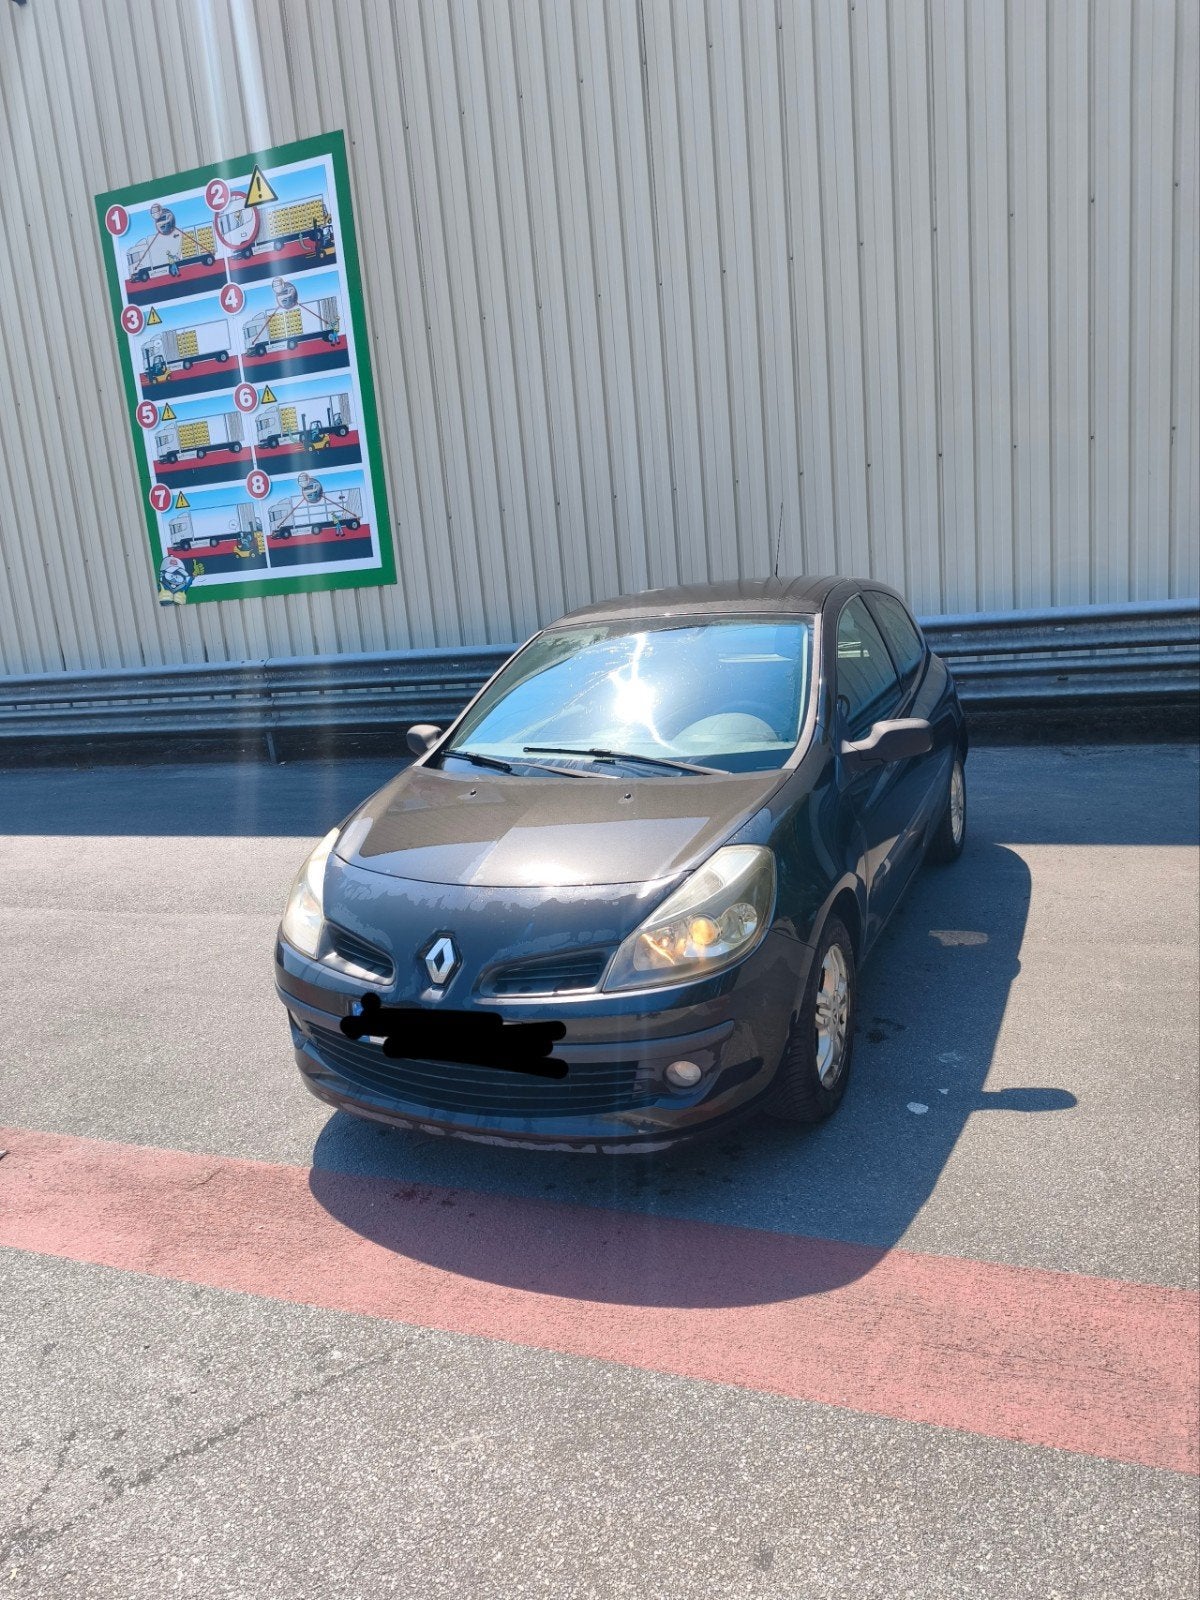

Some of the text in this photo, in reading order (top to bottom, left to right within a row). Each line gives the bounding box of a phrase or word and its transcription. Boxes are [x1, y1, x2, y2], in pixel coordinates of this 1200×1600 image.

[211, 184, 225, 205] 2
[111, 210, 121, 230] 1
[224, 289, 238, 309] 4
[127, 310, 139, 329] 3
[239, 388, 252, 407] 6
[143, 406, 154, 424] 5
[251, 476, 264, 494] 8
[155, 489, 166, 508] 7
